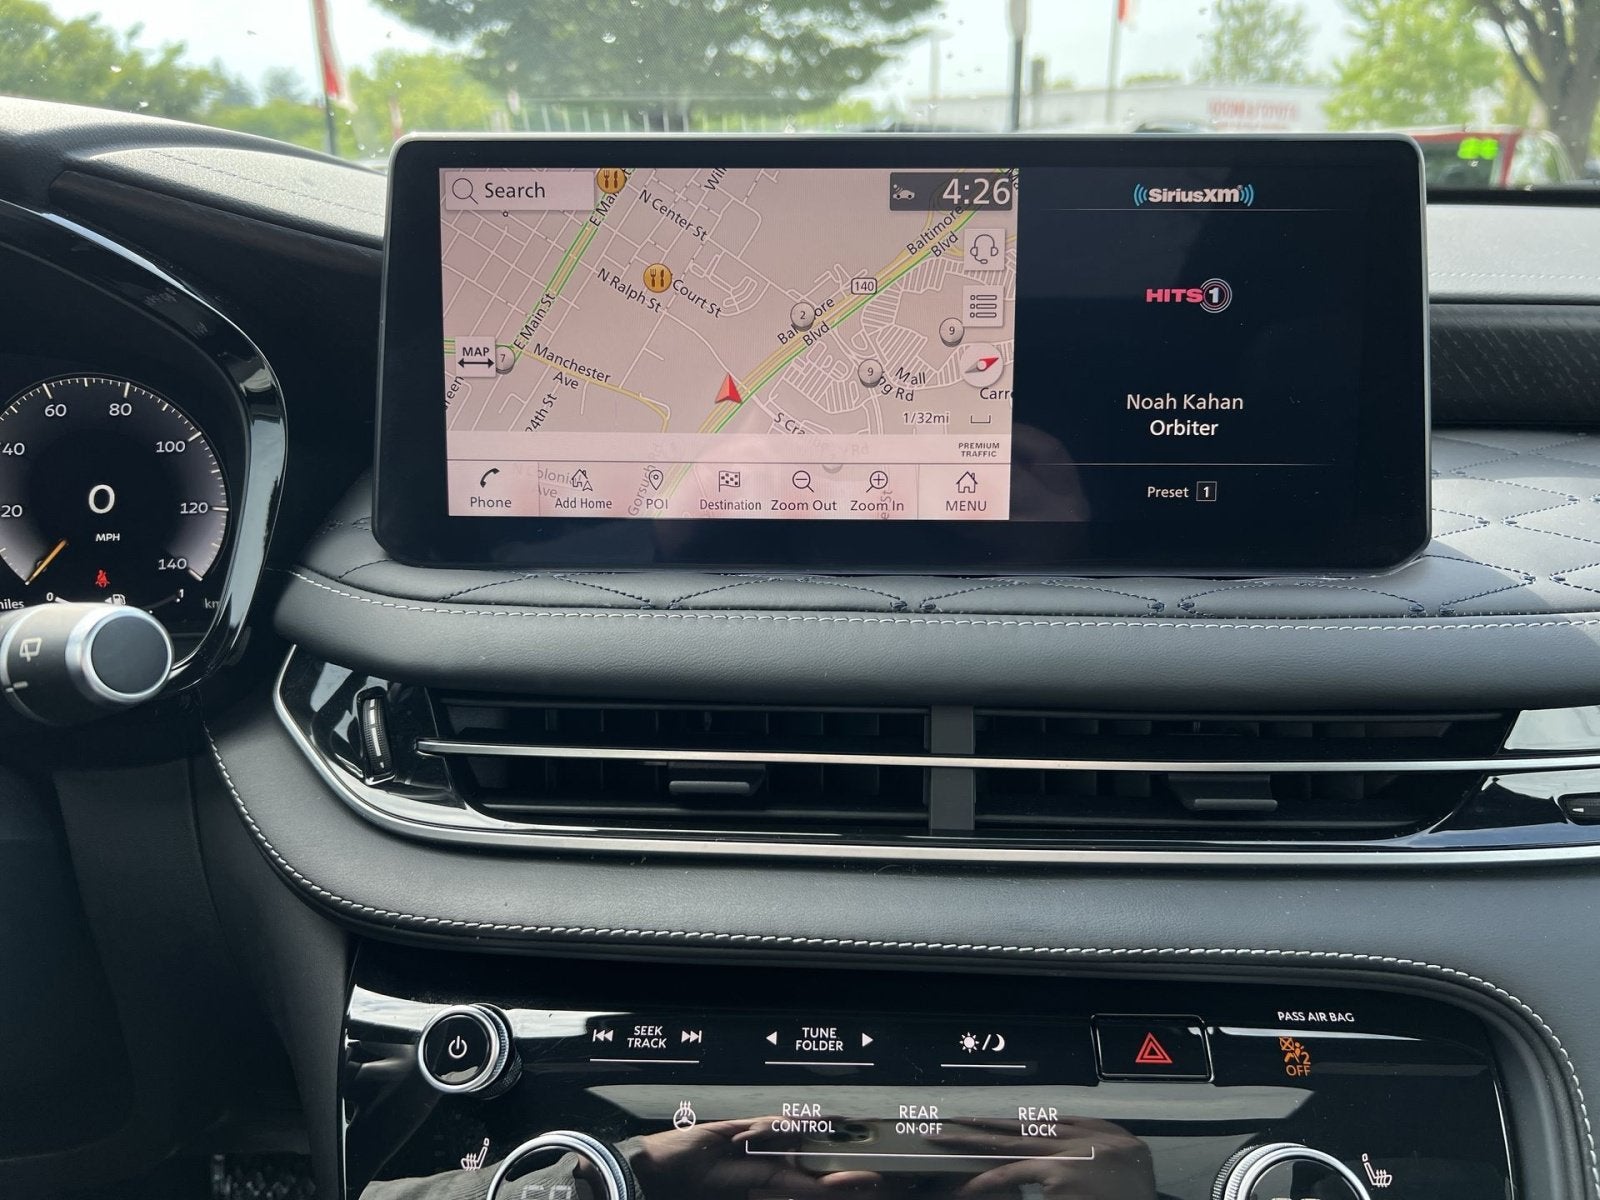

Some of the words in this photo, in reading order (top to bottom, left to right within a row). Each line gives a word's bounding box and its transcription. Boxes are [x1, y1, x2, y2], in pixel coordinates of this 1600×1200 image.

[485, 182, 545, 199] Search
[942, 178, 1010, 205] 4:26
[589, 215, 602, 226] E
[596, 190, 620, 216] Mai
[638, 190, 652, 204] N
[652, 198, 693, 231] Center
[693, 226, 708, 242] St
[906, 204, 963, 255] Baltimore
[931, 231, 958, 257] Blvd
[597, 268, 610, 282] N
[610, 275, 645, 304] Ralph
[646, 300, 662, 313] St
[854, 282, 874, 292] 140
[672, 279, 706, 307] Court
[704, 302, 722, 318] St
[1146, 288, 1203, 302] HITS
[514, 339, 526, 350] E
[520, 306, 547, 342] Main
[540, 293, 556, 308] St
[777, 299, 834, 344] Balore
[800, 310, 806, 320] 2
[803, 321, 830, 346] Blvd
[948, 326, 956, 335] 9
[462, 346, 490, 357] MAP
[500, 354, 506, 362] 7
[534, 343, 612, 384] Manchester
[868, 368, 874, 376] 9
[895, 367, 926, 385] Mall
[553, 372, 579, 390] Ave
[542, 393, 558, 408] St
[896, 388, 914, 402] Rd
[1126, 394, 1177, 410] Noah
[1184, 394, 1244, 410] Kahan
[44, 404, 67, 416] 60
[109, 403, 132, 416] 80
[904, 412, 950, 424] 1/32mi
[1150, 420, 1219, 436] Orbiter
[2, 442, 25, 456] 40
[156, 440, 186, 453] 100
[1147, 486, 1190, 498] Preset
[88, 484, 116, 514] 0
[470, 496, 512, 509] Phone
[554, 498, 576, 509] Add
[580, 498, 612, 510] Home
[646, 498, 668, 510] POI
[700, 498, 762, 511] Destination
[771, 500, 809, 511] Zoom
[812, 500, 838, 511] Out
[1, 504, 23, 518] 20
[180, 502, 208, 514] 120
[850, 500, 888, 512] Zoom
[892, 500, 905, 512] In
[945, 500, 988, 512] MENU
[95, 533, 120, 542] MPH
[158, 558, 188, 570] 140
[46, 592, 54, 602] 0
[180, 589, 184, 598] 1
[1278, 1012, 1306, 1020] PASS
[1308, 1012, 1328, 1022] AIR
[1328, 1012, 1355, 1022] BAG
[633, 1026, 663, 1036] SEEK
[802, 1028, 837, 1039] TUNE
[627, 1037, 667, 1049] TRACK
[795, 1040, 844, 1052] FOLDER
[1286, 1065, 1311, 1076] OFF
[782, 1104, 822, 1118] REAR
[898, 1106, 939, 1119] REAR
[1018, 1107, 1058, 1121] REAR
[771, 1120, 835, 1133] CONTROL
[1021, 1124, 1058, 1137] LOCK
